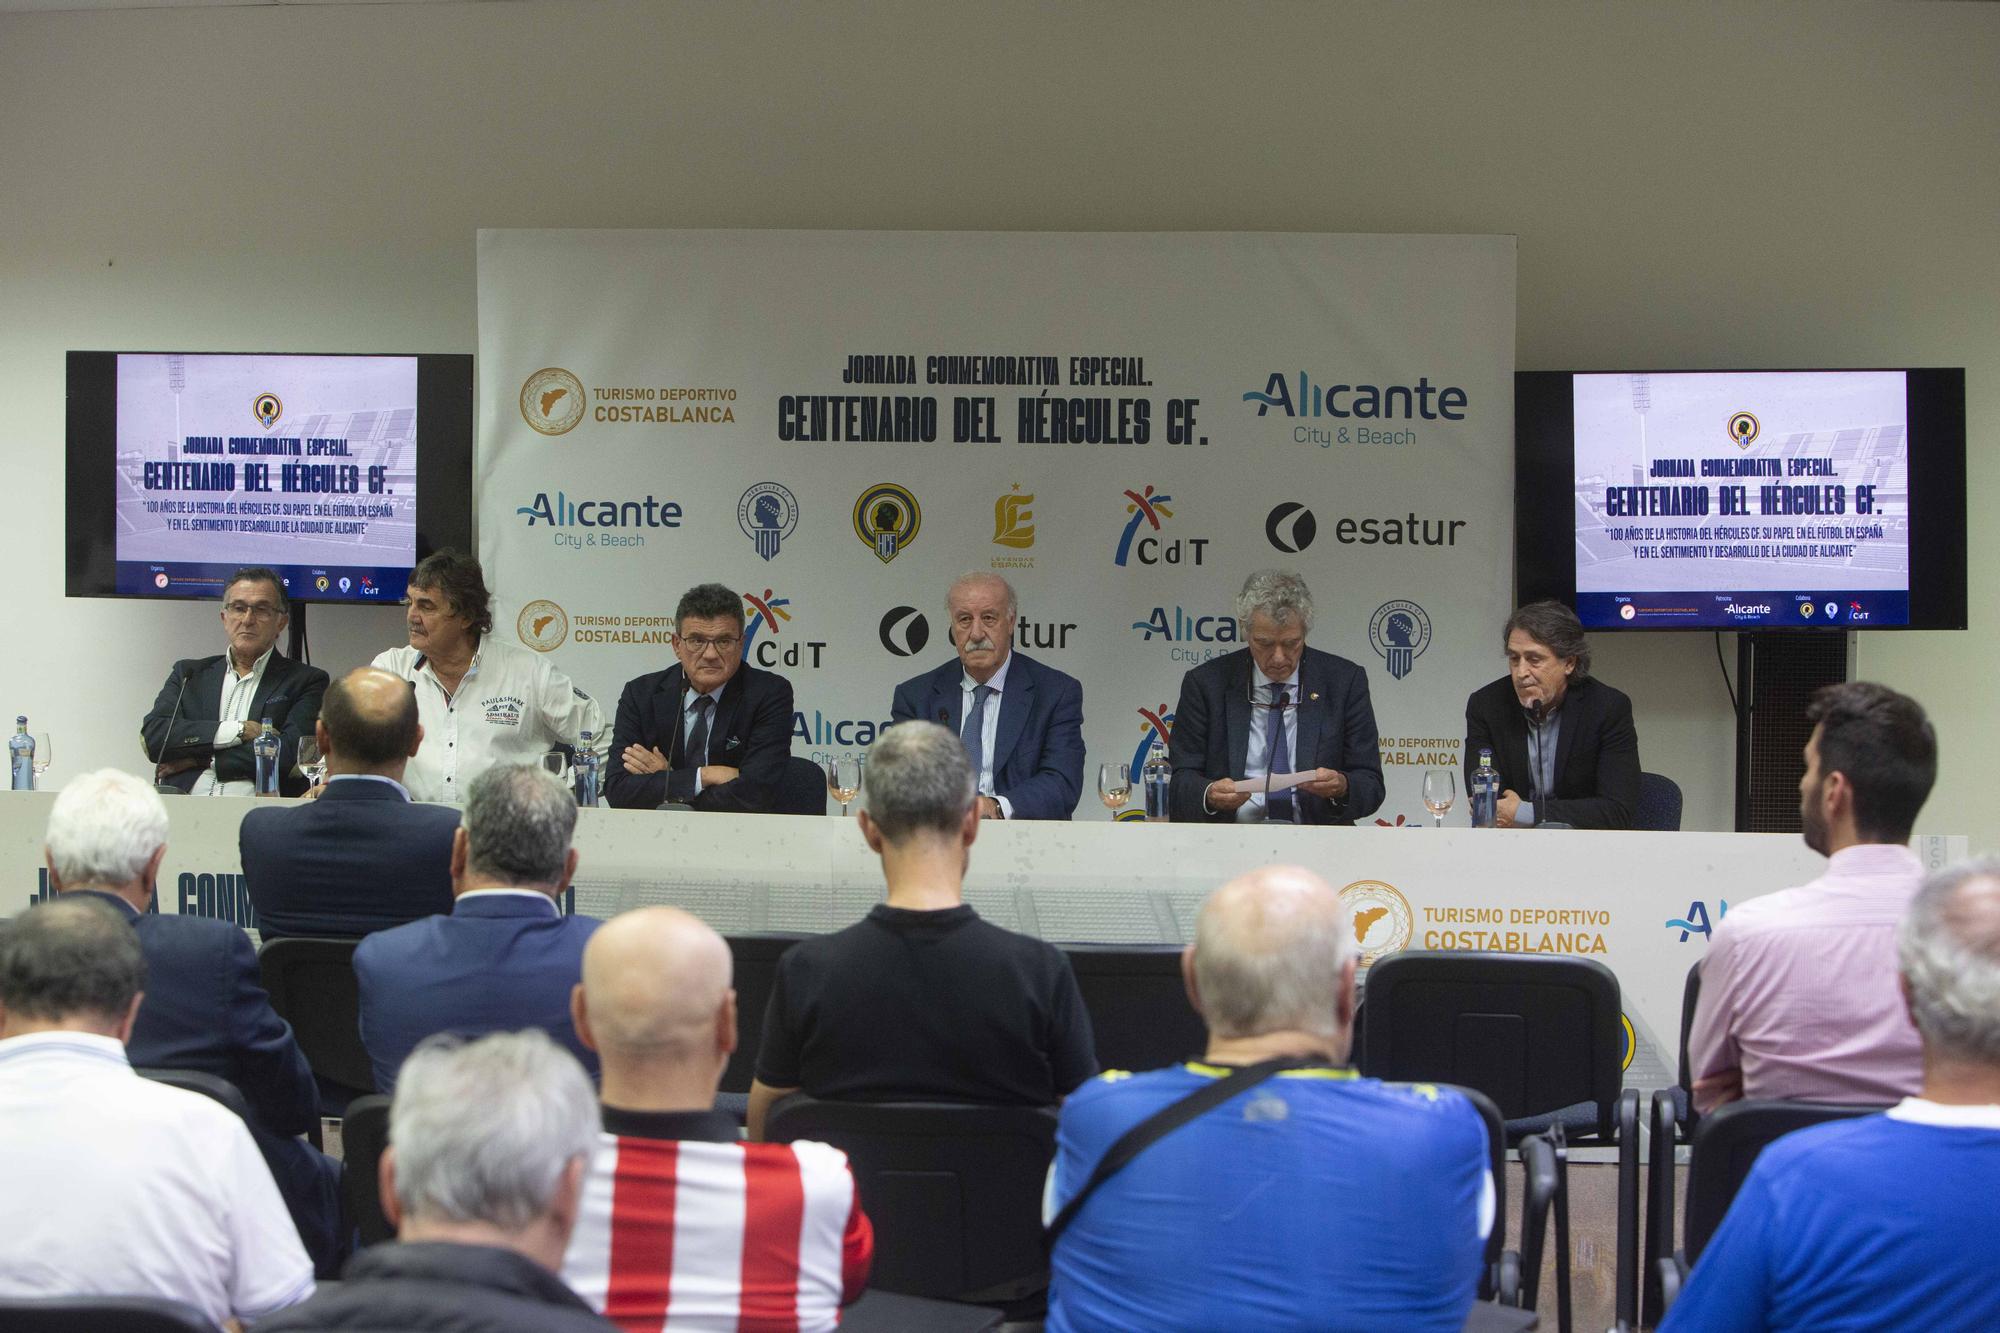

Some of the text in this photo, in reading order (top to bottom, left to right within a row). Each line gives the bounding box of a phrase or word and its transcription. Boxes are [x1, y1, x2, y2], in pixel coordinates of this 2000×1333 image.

[843, 355, 1153, 387] JORNADA CONMEMORATIVA ESPECIAL.
[593, 388, 737, 401] TURISMO DEPORTIVO
[1243, 370, 1468, 420] Alicante
[594, 406, 736, 423] COSTABLANCA
[778, 389, 1209, 446] CENTENARIO DEL HÉRCULES CF.
[1293, 426, 1417, 448] City & Beach
[183, 437, 353, 457] JORNADA CONMEMORATIVA ESPECIAL.
[1650, 458, 1838, 477] JORNADA CONMEMORATIVA ESPECIAL.
[144, 459, 393, 495] CENTENARIO DEL HÉRCULES CF.
[1606, 480, 1882, 516] CENTENARIO DEL HÉRCULES CF.
[178, 501, 186, 514] DE
[187, 502, 195, 514] LA
[196, 502, 225, 515] HISTORIA
[226, 502, 238, 515] DEL
[239, 501, 271, 516] HÉRCULES
[283, 503, 292, 516] SU
[293, 503, 312, 517] PAPEL
[314, 504, 322, 517] EN
[324, 504, 331, 517] EL
[358, 504, 367, 518] EN
[368, 503, 393, 518] ESPAÑA
[517, 491, 683, 528] Alicante
[167, 519, 171, 531] Y
[173, 519, 181, 531] EN
[183, 519, 190, 531] EL
[192, 519, 233, 532] SENTIMIENTO
[234, 519, 239, 532] Y
[240, 519, 280, 533] DESARROLLO
[281, 520, 290, 533] DE
[291, 521, 299, 533] LA
[300, 521, 324, 534] CIUDAD
[325, 521, 334, 534] DE
[1336, 512, 1467, 546] esatur
[1624, 526, 1643, 541] AÑOS
[1645, 528, 1654, 541] DE
[1655, 528, 1664, 541] LA
[1666, 527, 1698, 540] HISTORIA
[1699, 527, 1713, 540] DEL
[1714, 525, 1750, 540] HÉRCULES
[1751, 527, 1761, 540] CF.
[1763, 527, 1772, 540] SU
[1774, 527, 1795, 539] PAPEL
[1797, 527, 1806, 539] EN
[1808, 527, 1816, 539] EL
[1817, 524, 1844, 539] FÚTBOL
[1845, 527, 1855, 539] EN
[1856, 524, 1883, 539] ESPAÑA
[554, 533, 645, 550] City & Beach
[1634, 546, 1639, 558] Y
[1640, 546, 1649, 558] EN
[1651, 546, 1659, 558] EL
[1661, 546, 1707, 558] SENTIMIENTO
[1708, 546, 1714, 558] Y
[1715, 545, 1759, 558] DESARROLLO
[1761, 545, 1770, 558] DE
[1772, 545, 1781, 557] LA
[1782, 545, 1808, 557] CIUDAD
[1809, 545, 1819, 557] DE
[1724, 603, 1771, 614] Alicante
[574, 616, 621, 627] TURISMO
[574, 630, 672, 644] COSTABLANC
[1171, 648, 1199, 664] City
[1398, 738, 1460, 749] DEPORTIVO
[1423, 907, 1611, 926] TURISMO DEPORTIVO
[1424, 930, 1608, 954] COSTABLANCA
